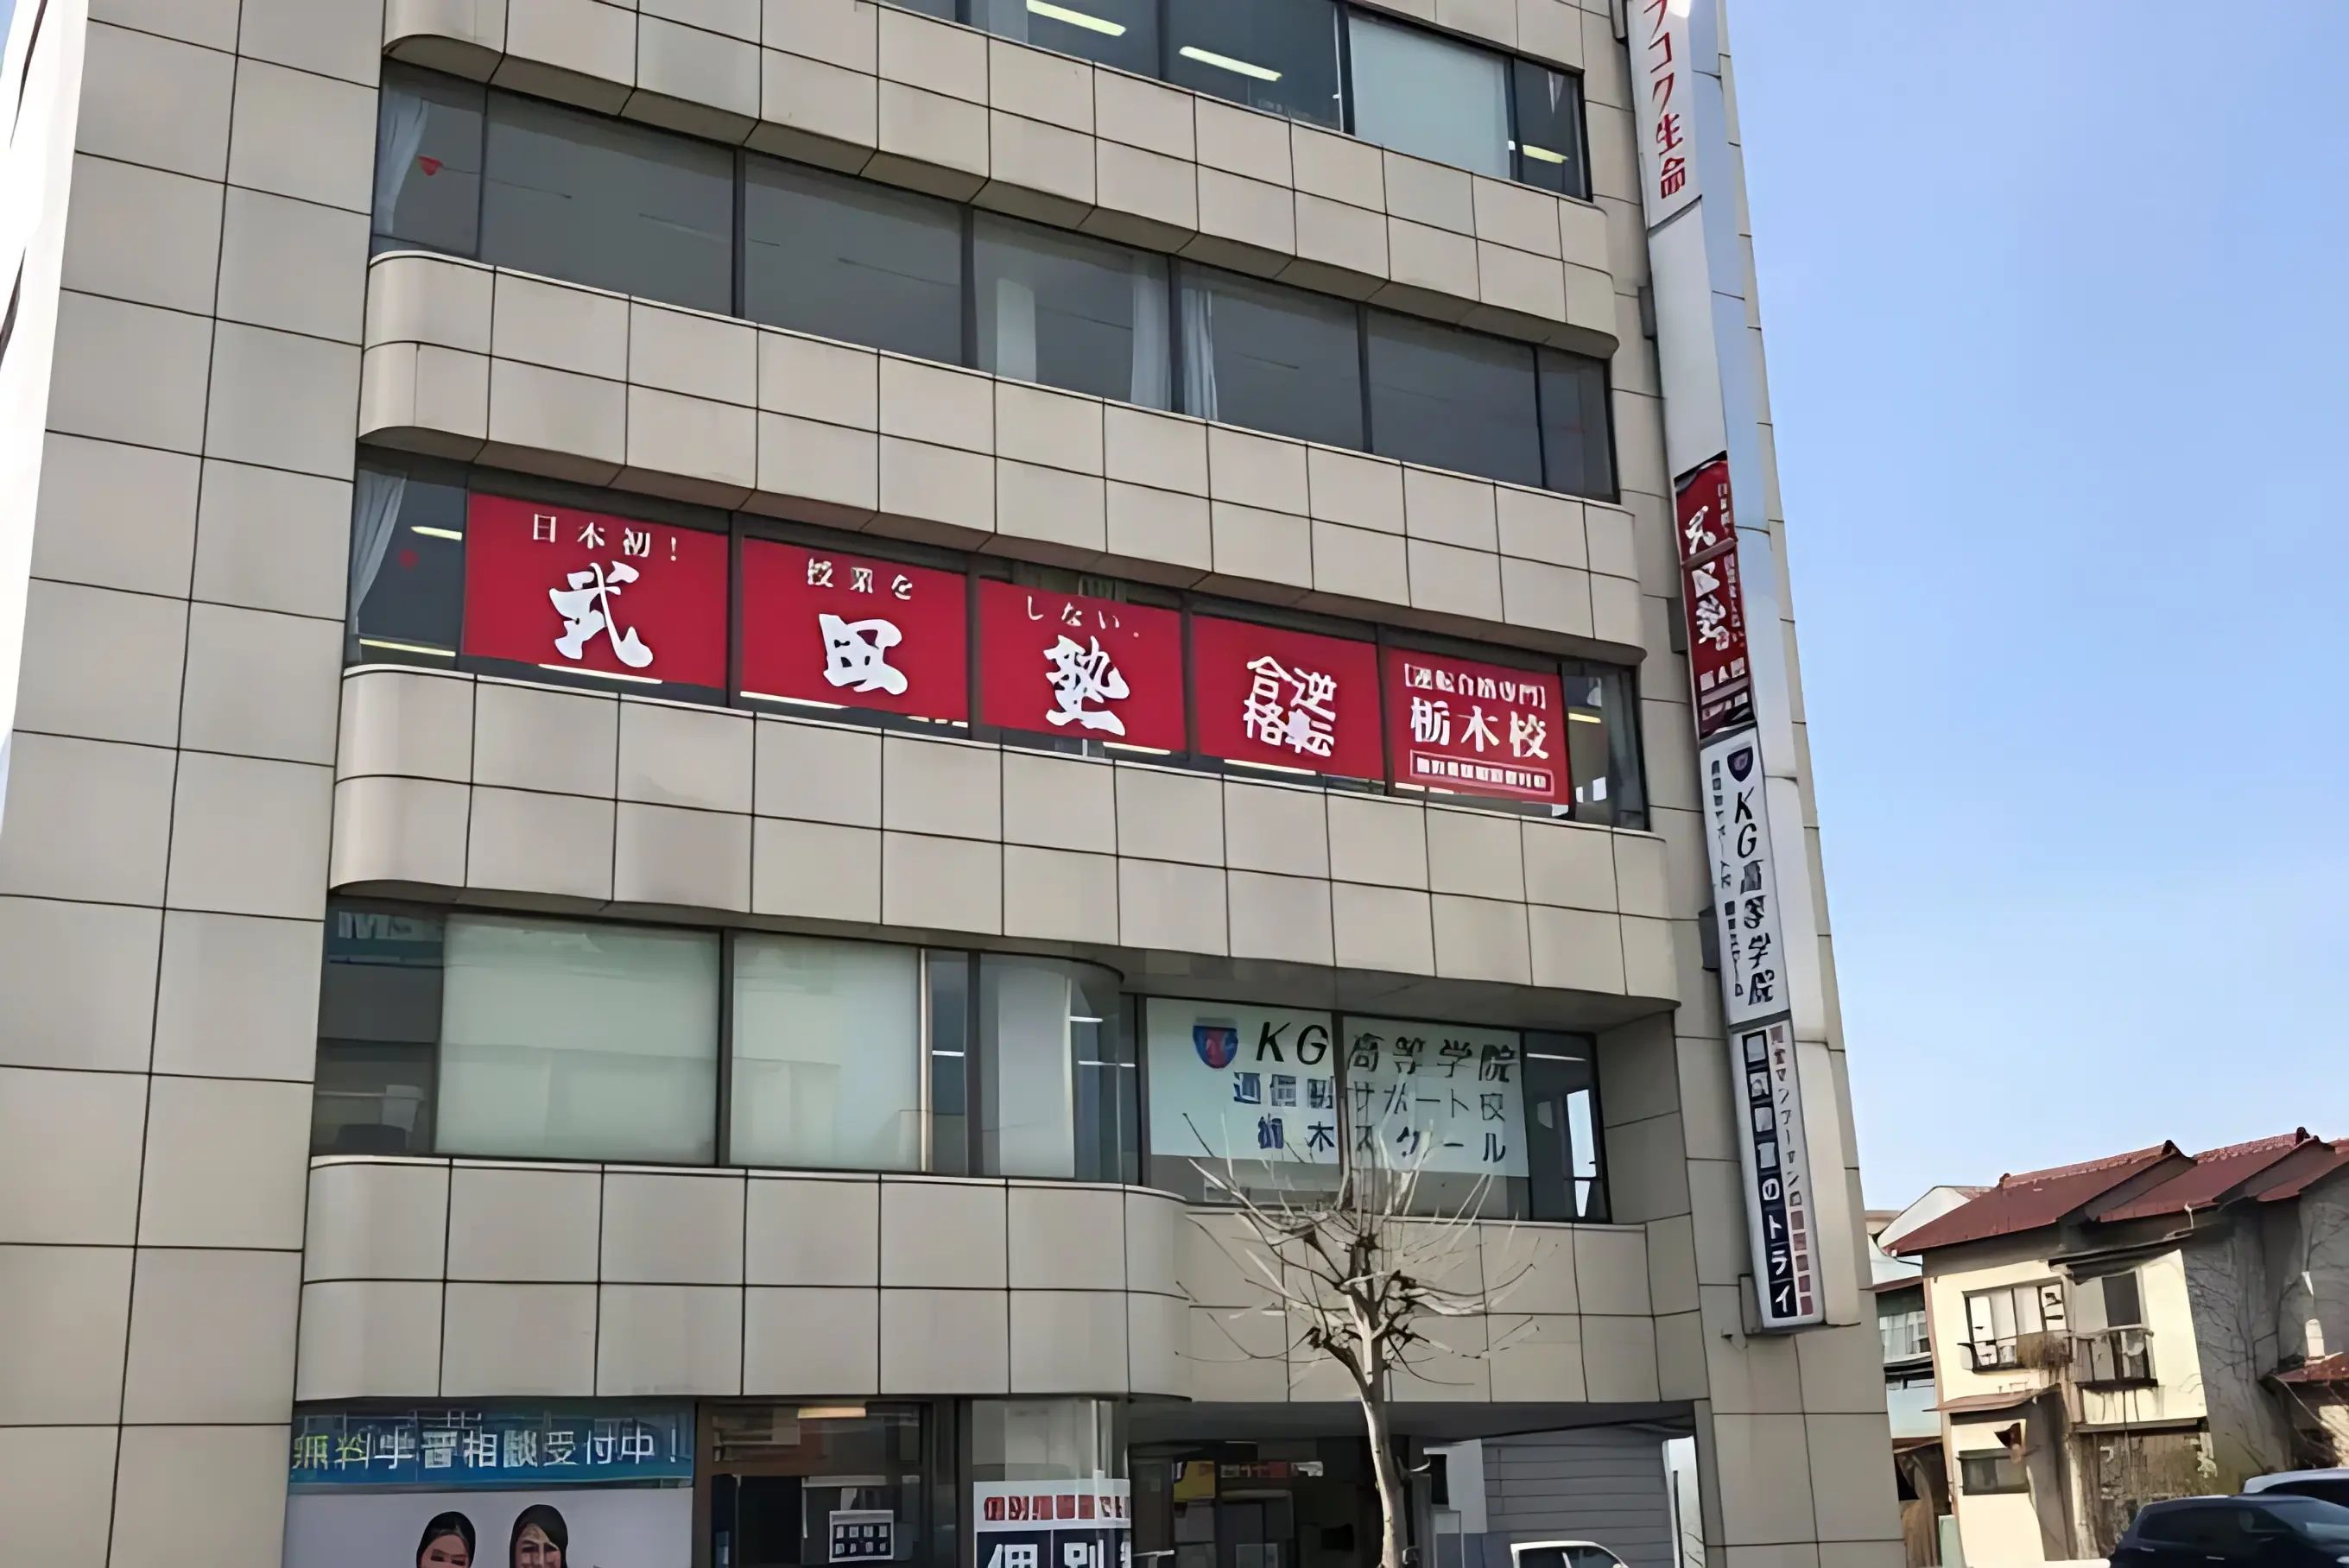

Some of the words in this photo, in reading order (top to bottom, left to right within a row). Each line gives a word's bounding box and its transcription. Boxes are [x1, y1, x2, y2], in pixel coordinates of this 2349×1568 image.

[1410, 696, 1549, 760] 栃木校
[1746, 1035, 1792, 1314] のトライ
